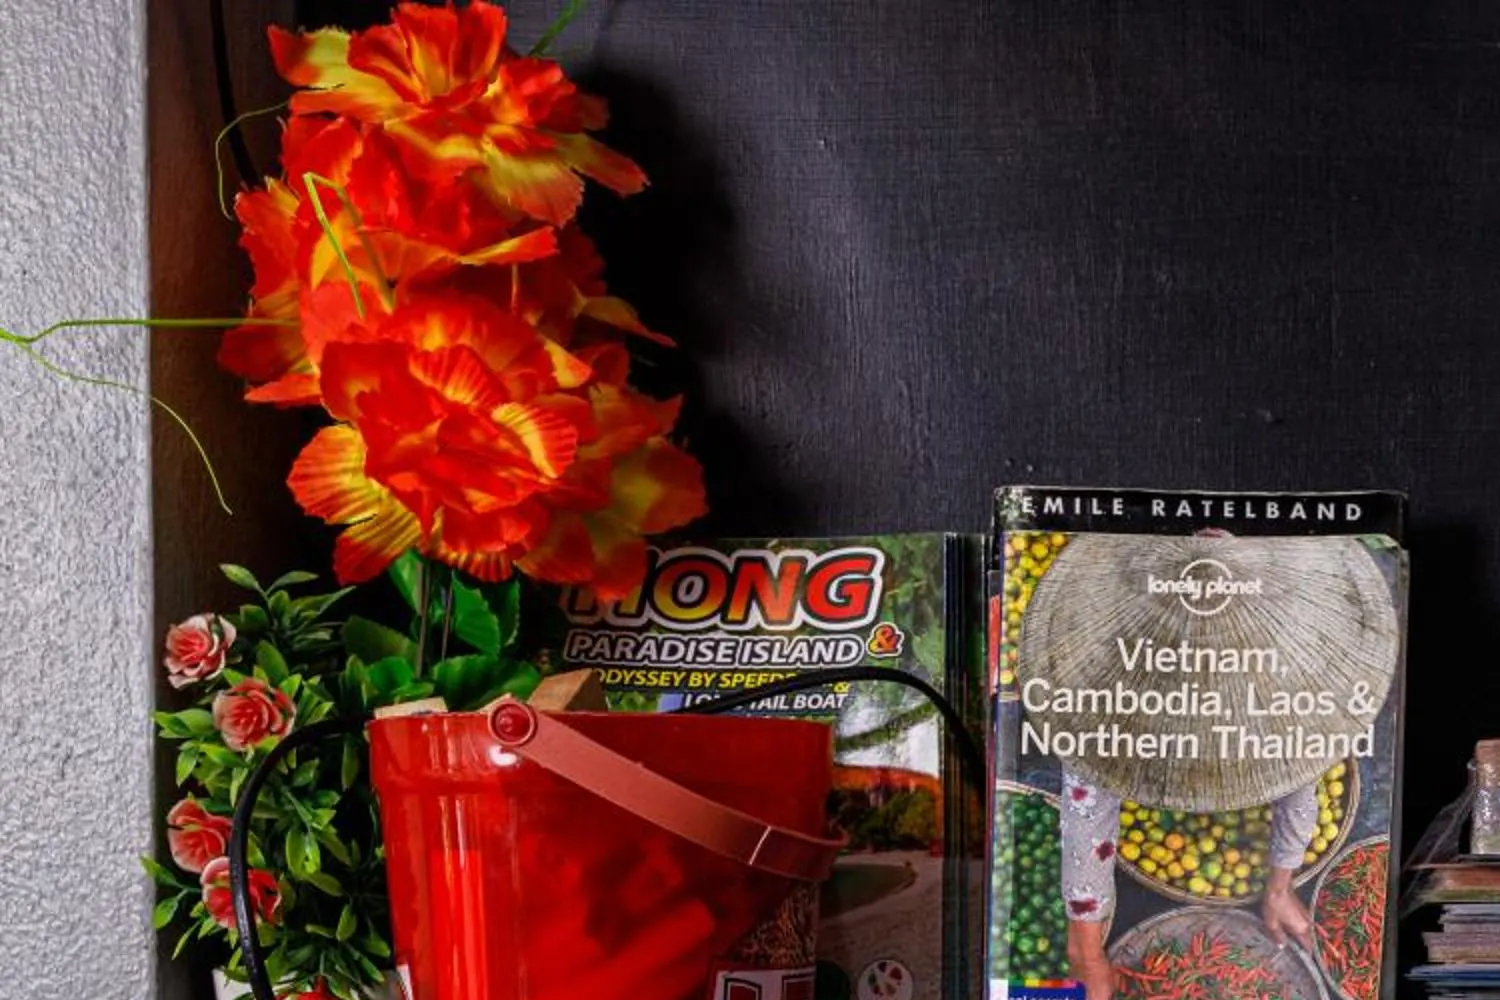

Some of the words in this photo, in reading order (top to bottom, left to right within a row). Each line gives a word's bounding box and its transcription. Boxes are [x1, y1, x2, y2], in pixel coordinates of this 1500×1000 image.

[1022, 496, 1124, 516] EMILE
[1152, 499, 1362, 521] RATELBAND
[1148, 574, 1201, 598] lonely
[1205, 576, 1263, 599] planet
[570, 636, 734, 665] PARADISE
[741, 638, 859, 665] ISLAND
[1117, 637, 1289, 677] Vietnam,
[688, 671, 717, 688] BY
[793, 694, 847, 710] BOAT
[1022, 678, 1232, 720] Cambodia,
[1247, 682, 1335, 717] Laos
[1347, 681, 1377, 716] &
[1021, 721, 1198, 759] Northern
[1211, 723, 1375, 759] Thailand
